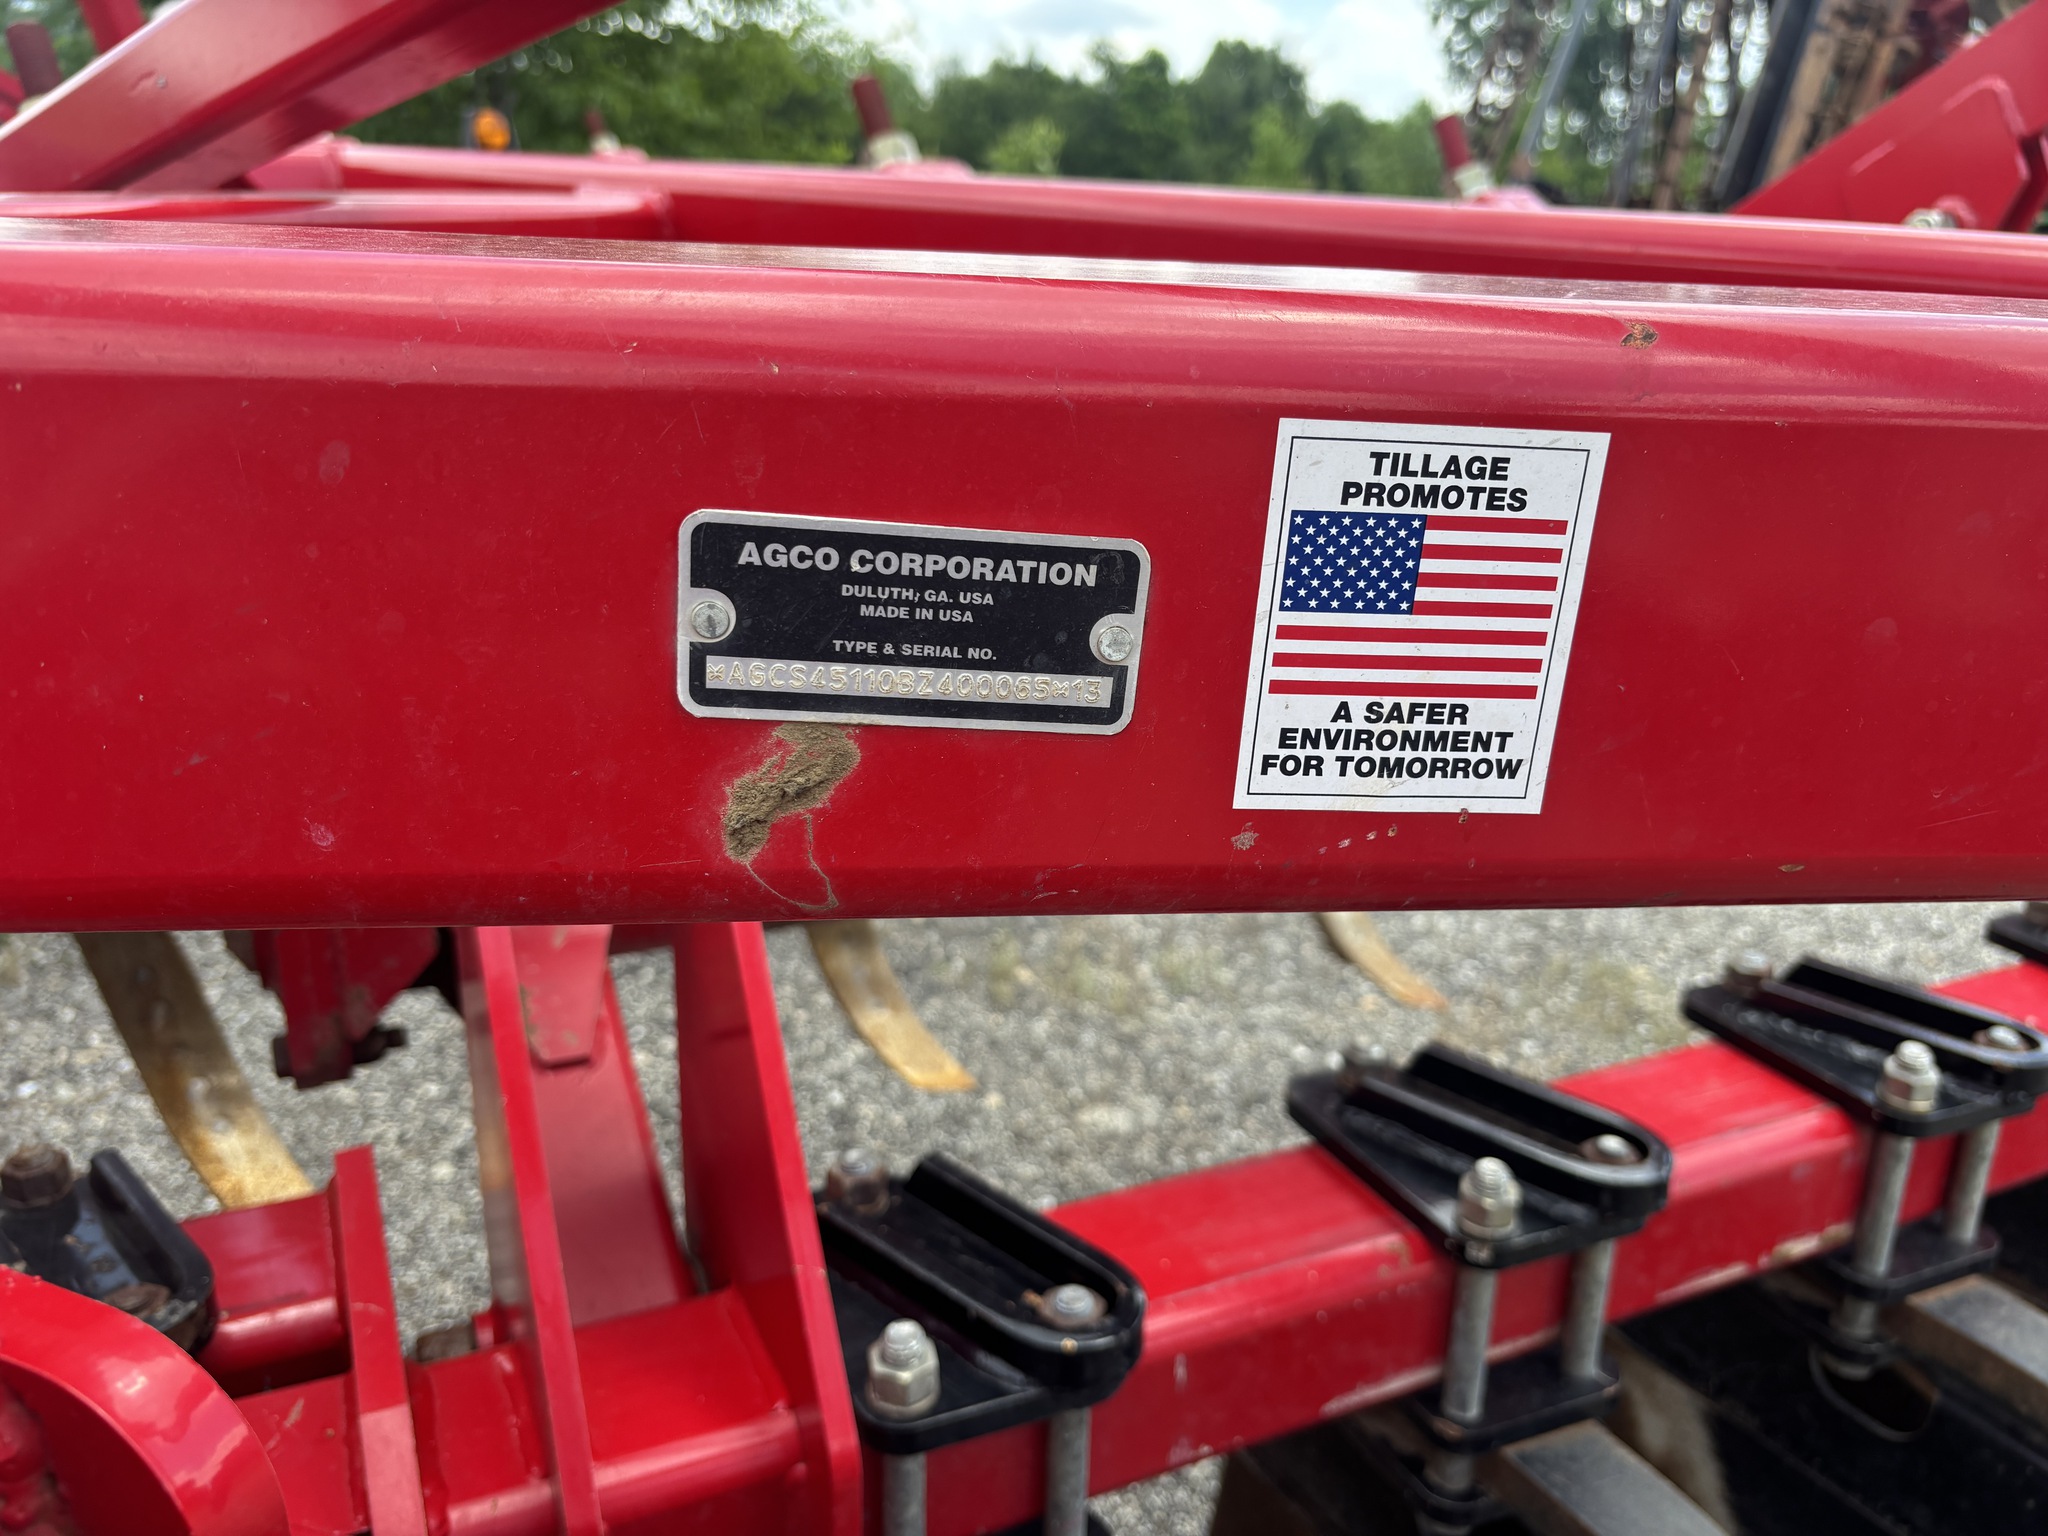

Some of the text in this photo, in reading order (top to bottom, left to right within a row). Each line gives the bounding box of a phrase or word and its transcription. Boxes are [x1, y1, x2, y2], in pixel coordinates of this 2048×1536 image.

[1369, 452, 1511, 481] TILLAGE
[1340, 482, 1528, 512] PROMOTES
[737, 541, 1098, 586] AGCO CORPORATION
[924, 590, 954, 603] GA.
[959, 592, 994, 606] USA
[860, 605, 974, 623] MADE IN USA
[832, 640, 997, 661] TYPE & SERIAL NO.
[1330, 701, 1469, 725] A SAFER
[1278, 728, 1513, 753] ENVIRONMENT
[1260, 754, 1524, 780] FOR TOMORROW
